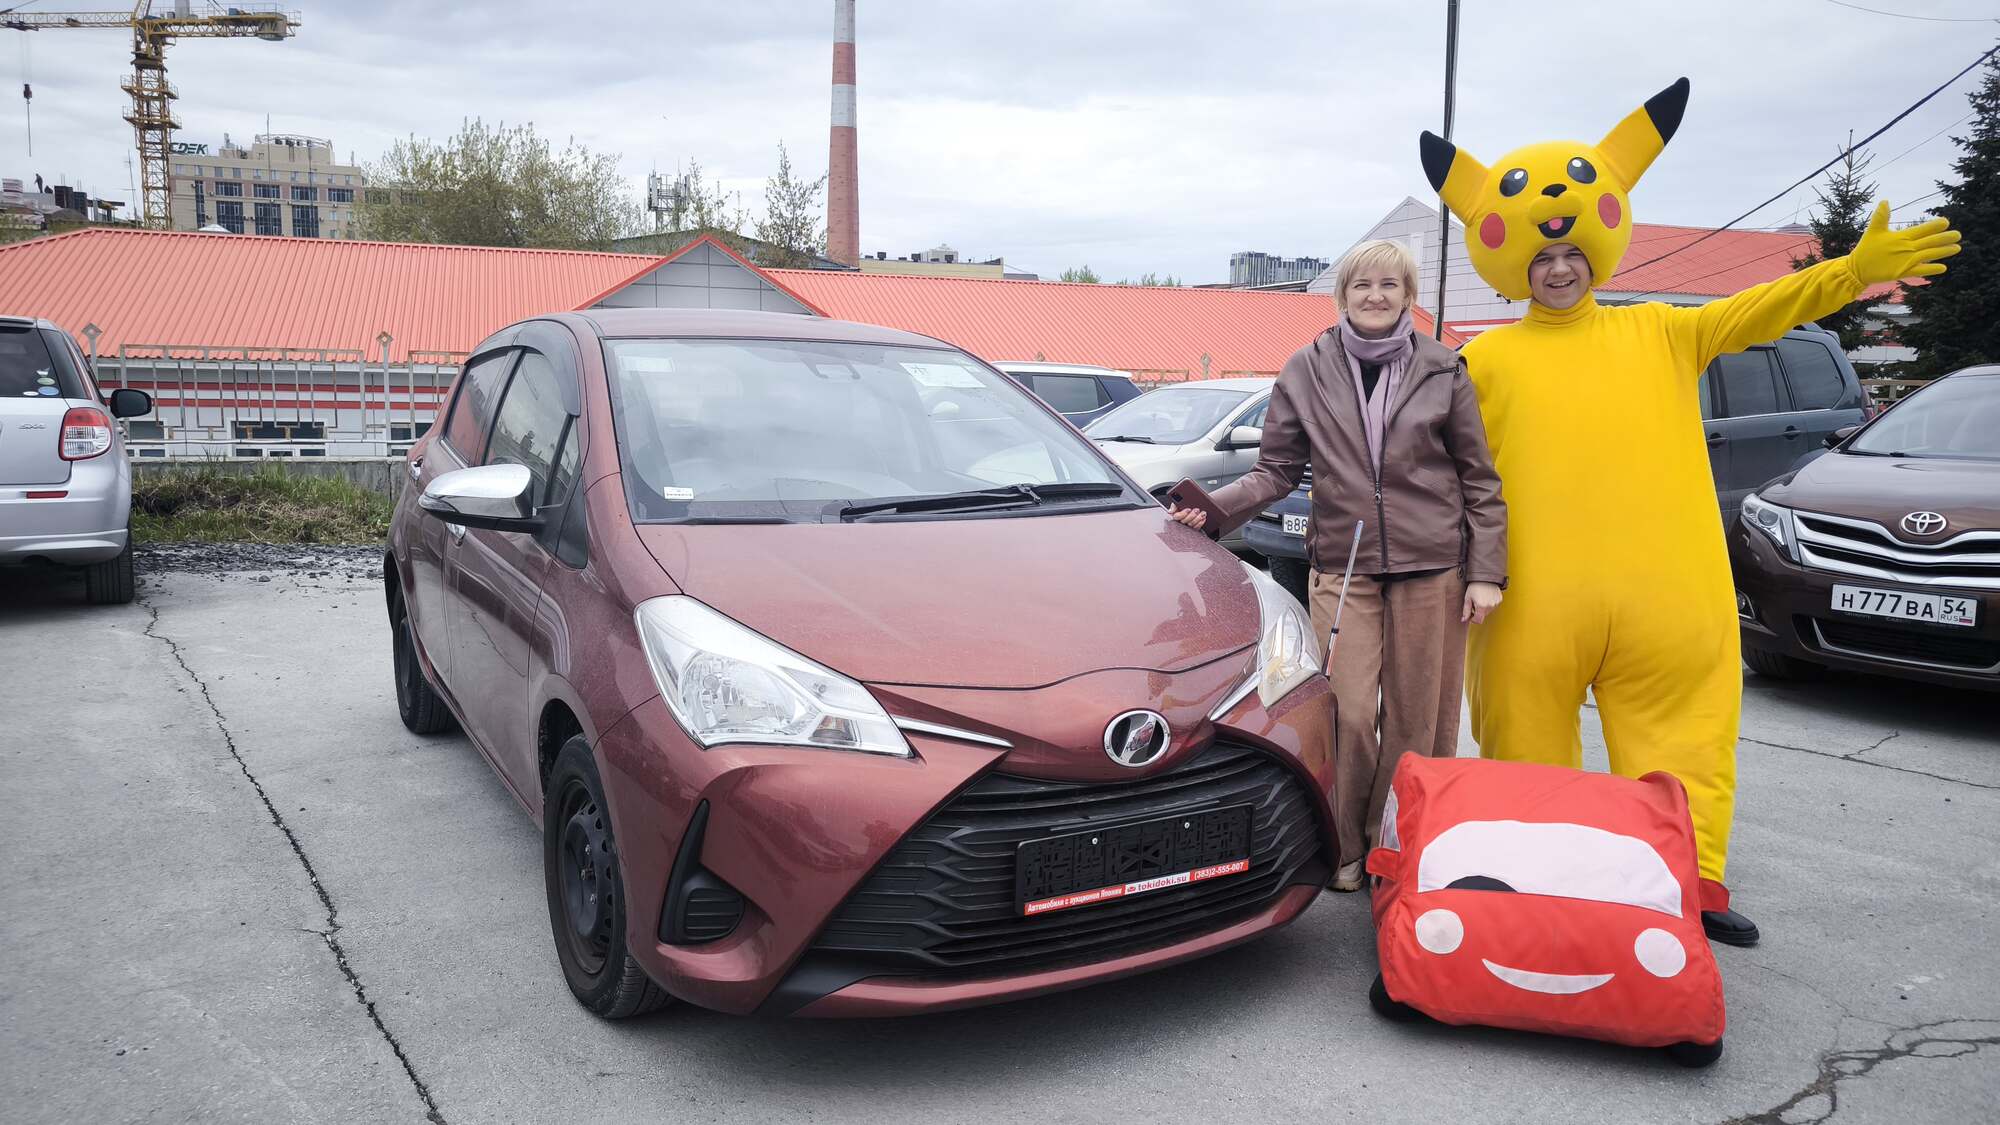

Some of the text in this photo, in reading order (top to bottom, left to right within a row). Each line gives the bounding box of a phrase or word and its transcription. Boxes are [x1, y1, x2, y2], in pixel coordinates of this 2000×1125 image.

[1943, 598, 1967, 617] 54
[1940, 613, 1960, 622] RUS
[1137, 875, 1187, 892] tokidoki.su
